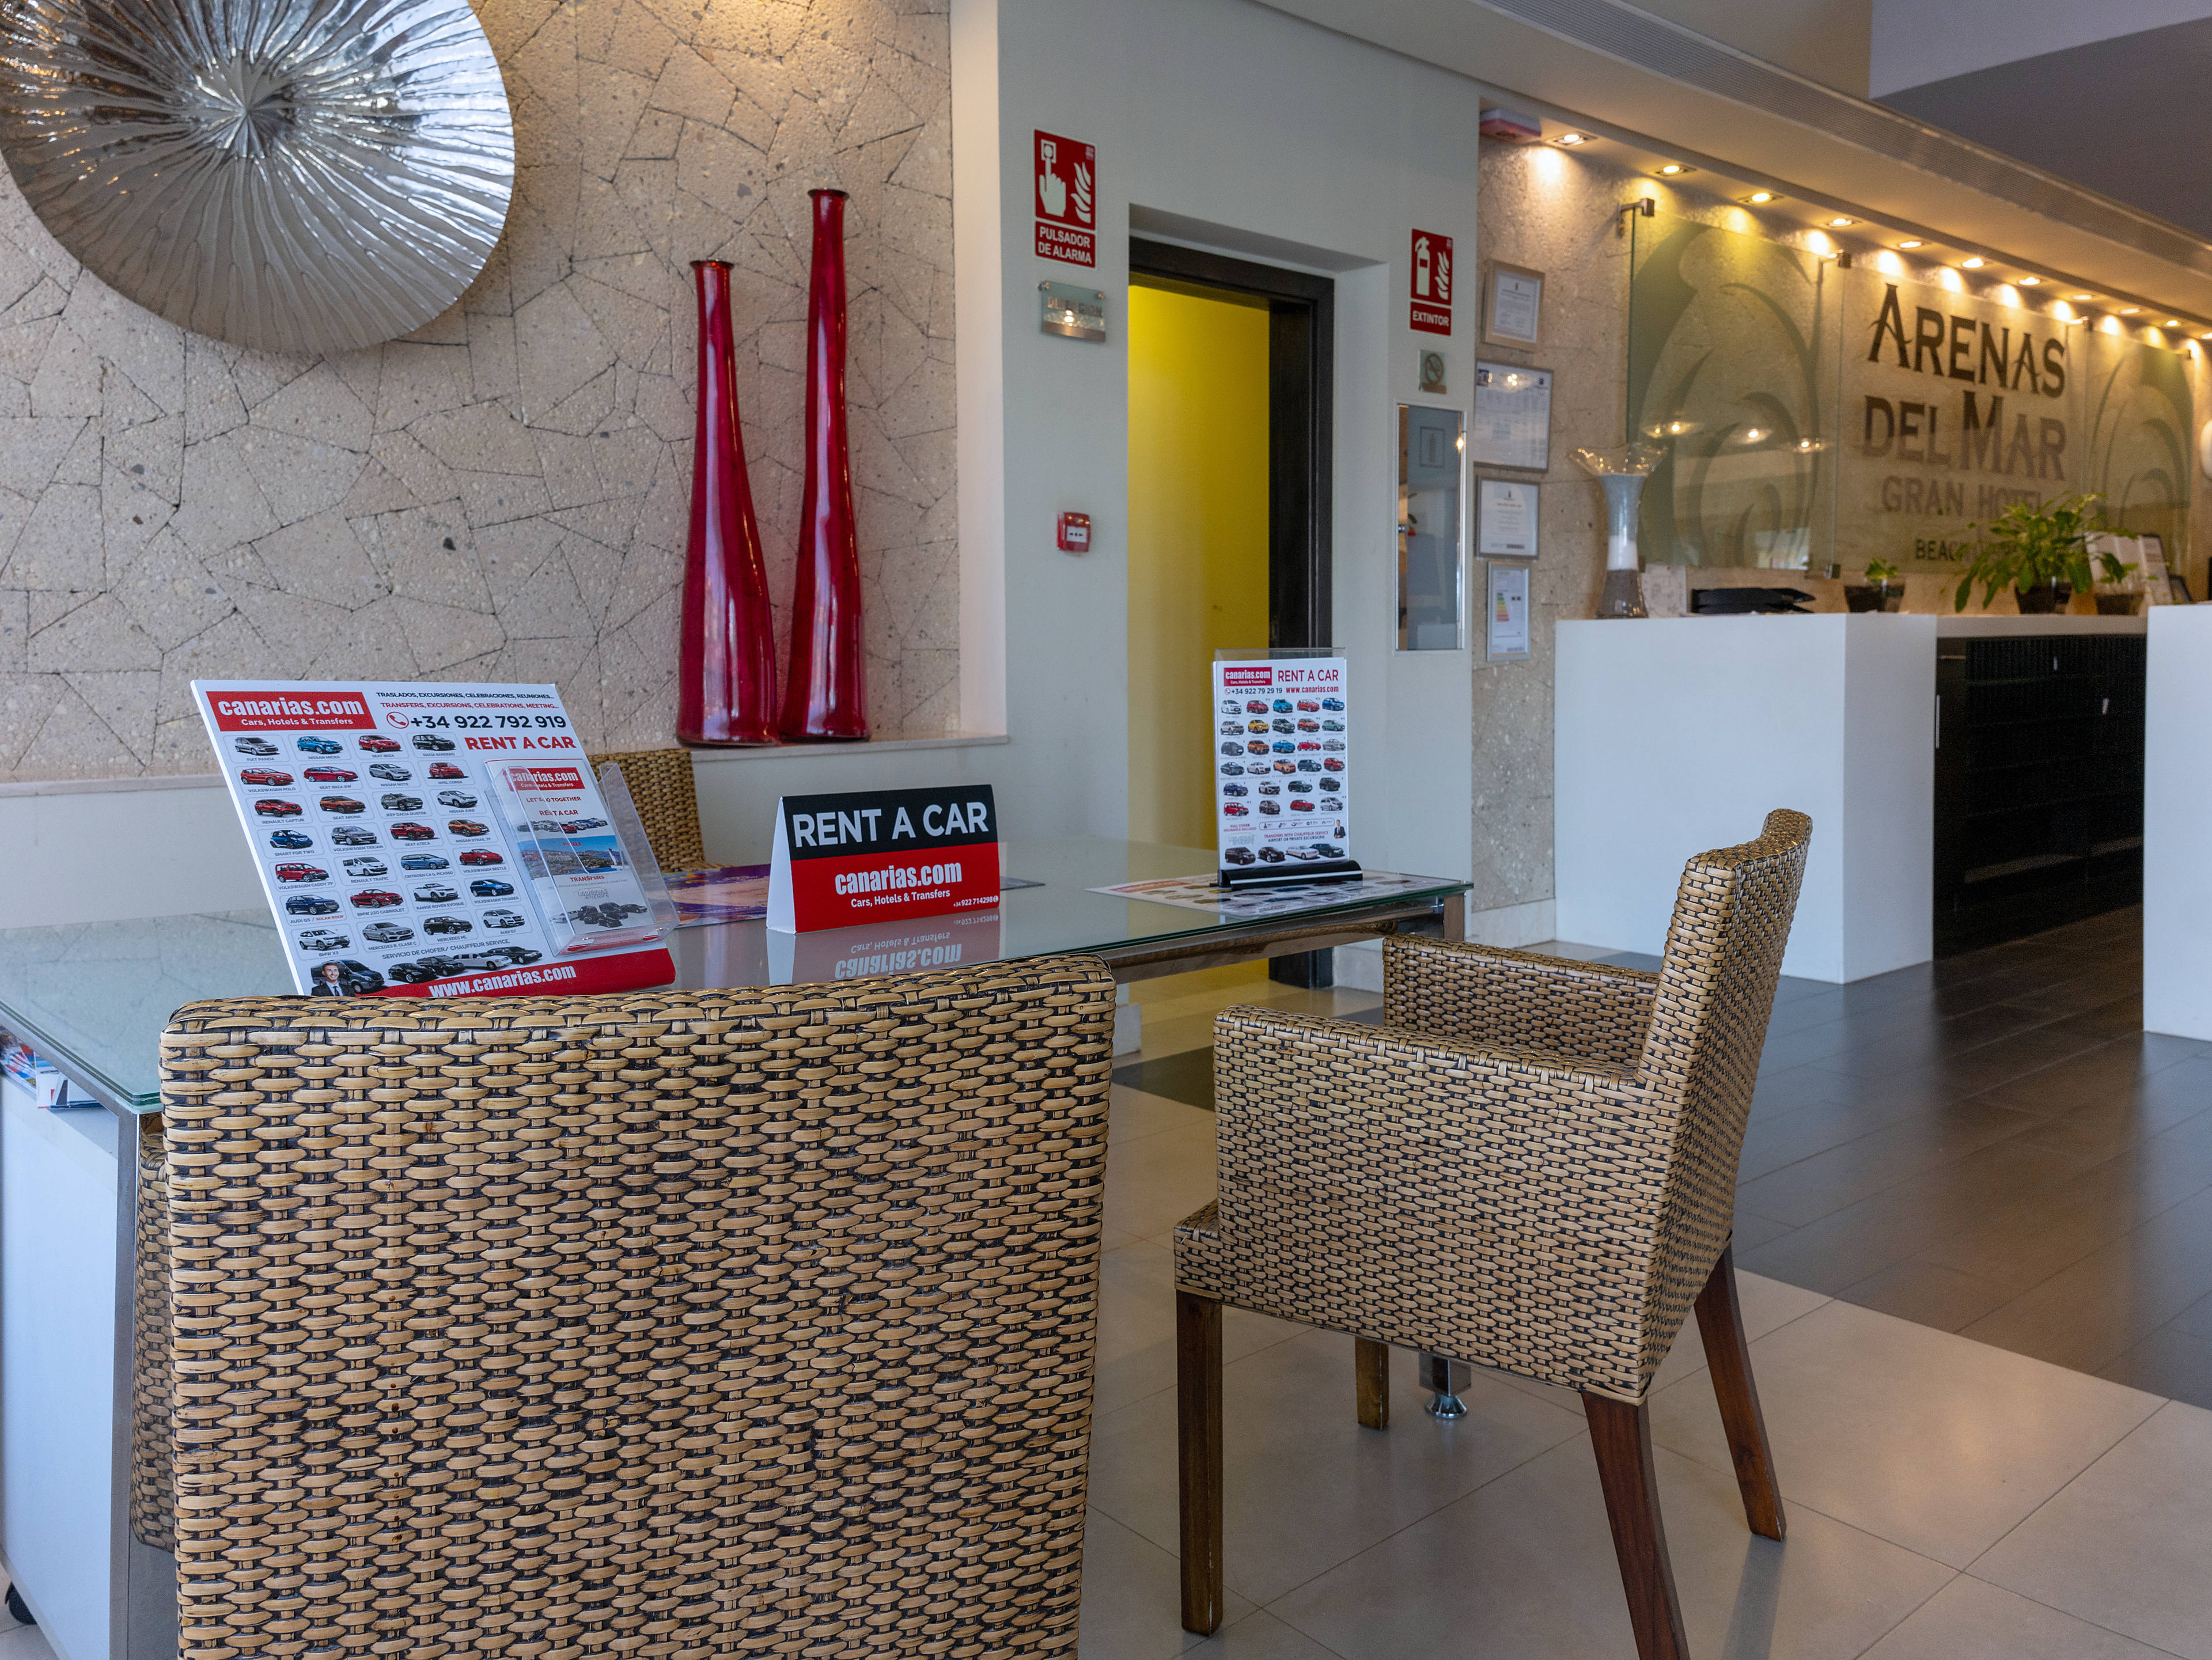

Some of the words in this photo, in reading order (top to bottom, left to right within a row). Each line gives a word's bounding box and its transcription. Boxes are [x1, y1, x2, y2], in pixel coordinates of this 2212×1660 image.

[1040, 226, 1090, 248] PULSADOR
[1038, 241, 1051, 255] DE
[1052, 244, 1092, 264] ALARMA
[1412, 310, 1449, 327] EXTINTOR
[1868, 283, 2066, 399] ARENAS
[1862, 395, 1950, 465] DEL
[1961, 390, 2066, 481] MAR
[1881, 476, 1964, 517] GRAN
[1225, 669, 1270, 680] canarias.com
[1278, 670, 1305, 682] RENT
[1308, 670, 1315, 681] A
[1318, 669, 1339, 681] CAR
[218, 697, 364, 715] canarias.com
[241, 719, 267, 727] Cars,
[411, 715, 449, 728] +34
[454, 715, 493, 728] 922
[495, 715, 532, 728] 792
[535, 715, 566, 728] 919
[464, 737, 516, 750] RENT
[523, 737, 536, 749] A
[537, 736, 577, 749] CAR
[793, 808, 882, 848] RENT
[892, 806, 916, 840] A
[923, 802, 990, 837] CAR
[835, 862, 962, 895] canarias.com
[851, 898, 873, 908] Cars,
[874, 893, 902, 905] Hotels
[904, 893, 910, 902] &
[911, 889, 950, 901] Transfers
[972, 896, 993, 905] 714298
[450, 942, 484, 950] CHAUFFEUR
[429, 965, 577, 997] www.canarias.com
